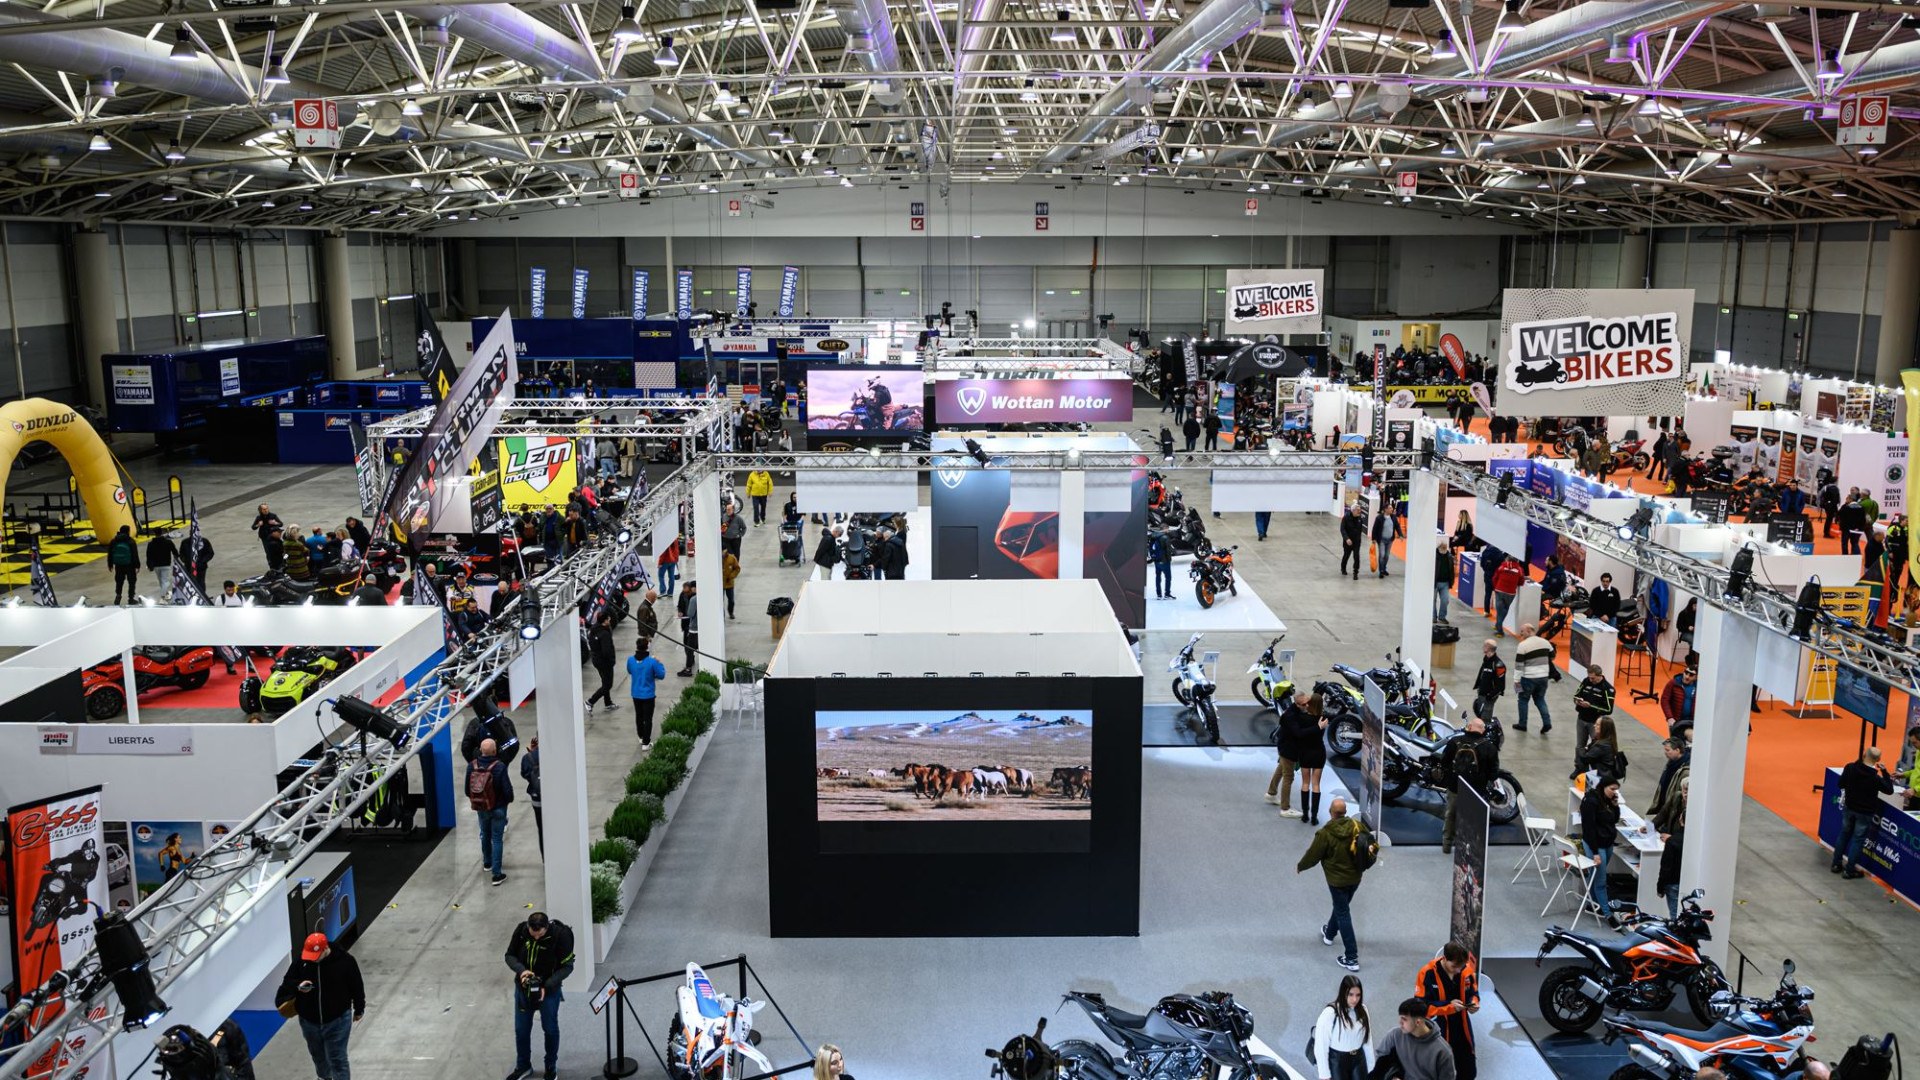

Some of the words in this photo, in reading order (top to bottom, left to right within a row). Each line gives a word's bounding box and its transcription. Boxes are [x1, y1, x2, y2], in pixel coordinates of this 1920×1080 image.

[533, 274, 542, 307] YAMAHA
[574, 274, 585, 308] YAMAHA
[634, 276, 644, 309] YAMAHA
[679, 276, 689, 309] YAMAHA
[738, 273, 748, 306] YAMAHA
[781, 272, 794, 305] YAMAHA
[1237, 284, 1314, 304] WELCOME
[1259, 299, 1315, 316] BIKERS
[730, 343, 757, 351] YAMAHA
[819, 341, 846, 349] FAIETA
[1522, 317, 1672, 357] WELCOME
[1565, 347, 1673, 382] BIKERS
[991, 396, 1053, 409] Wottan
[1059, 396, 1112, 409] Motor
[26, 412, 77, 431] DUNLOP
[507, 442, 573, 474] LEM
[505, 468, 549, 485] MOTOR
[43, 737, 68, 745] days
[108, 736, 155, 745] LIBERTAS
